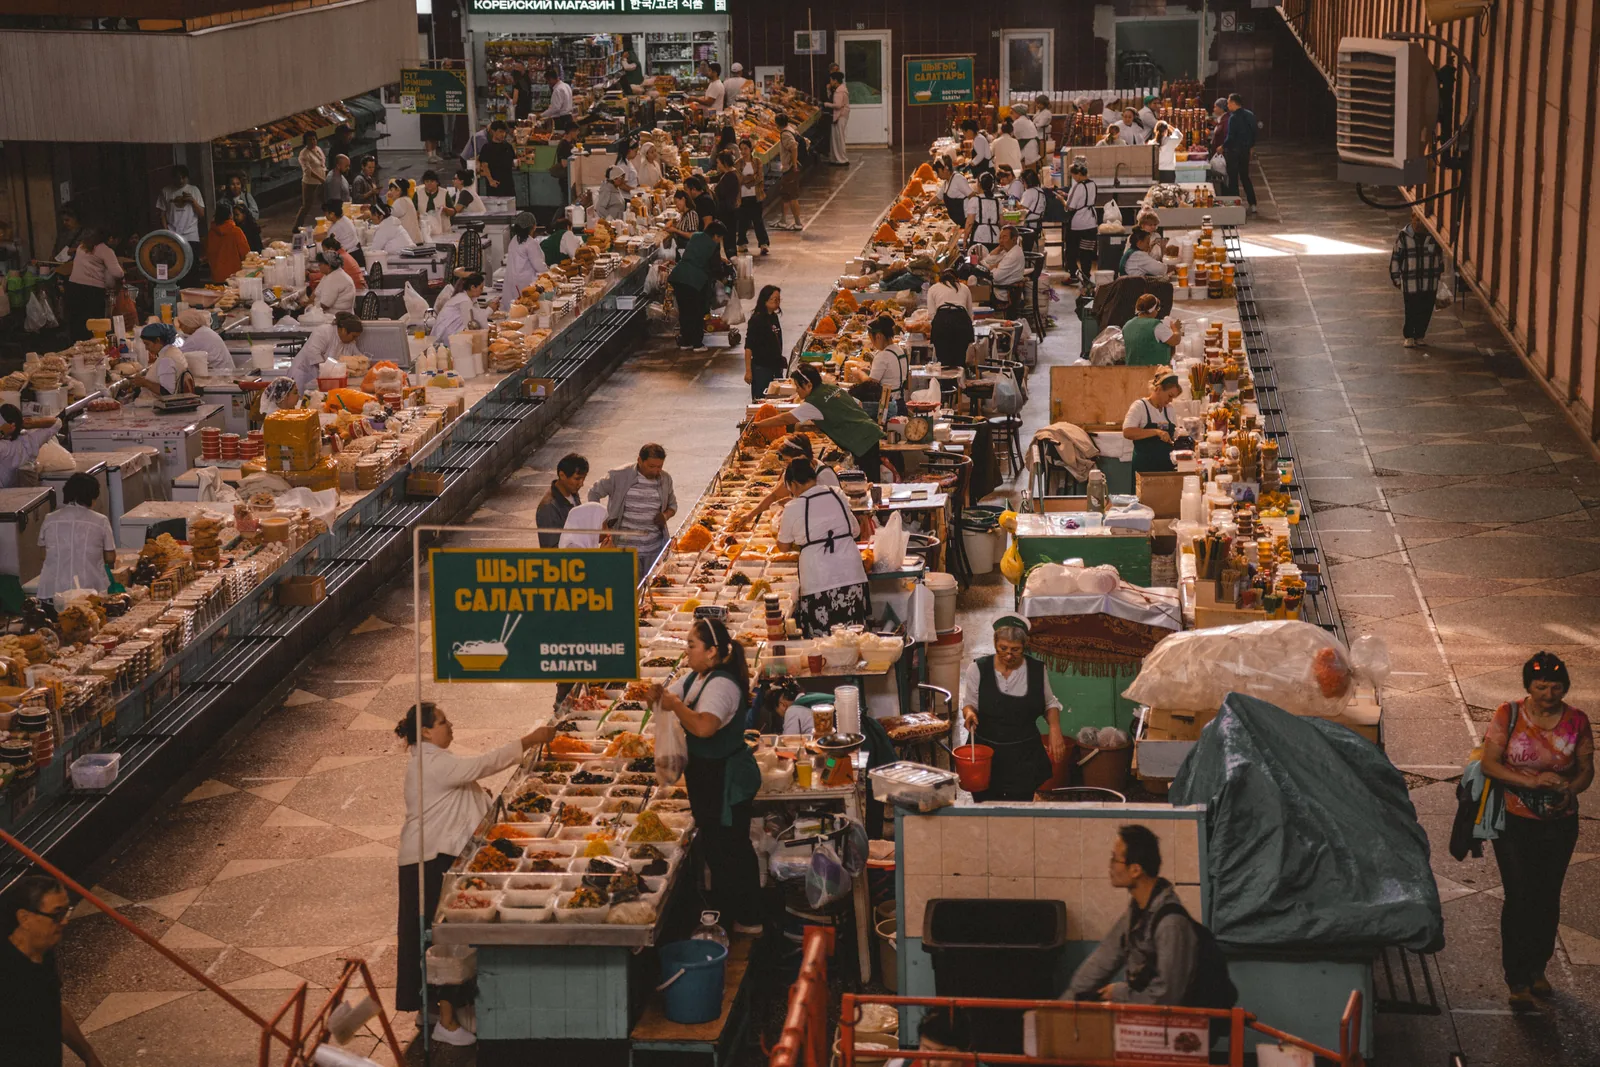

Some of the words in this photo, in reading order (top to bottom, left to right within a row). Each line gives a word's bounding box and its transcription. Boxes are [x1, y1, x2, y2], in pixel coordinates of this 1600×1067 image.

[474, 0, 553, 10] КОРЕЙСКИЙ
[554, 0, 615, 10] МАГАЗИН
[914, 71, 966, 81] САЛАТТАРЫ
[476, 559, 586, 582] ШЫҒЫС
[455, 588, 613, 611] САЛАТТАРЫ
[540, 643, 625, 656] ВОСТОЧНЫЕ
[540, 660, 597, 672] САЛАТЫ
